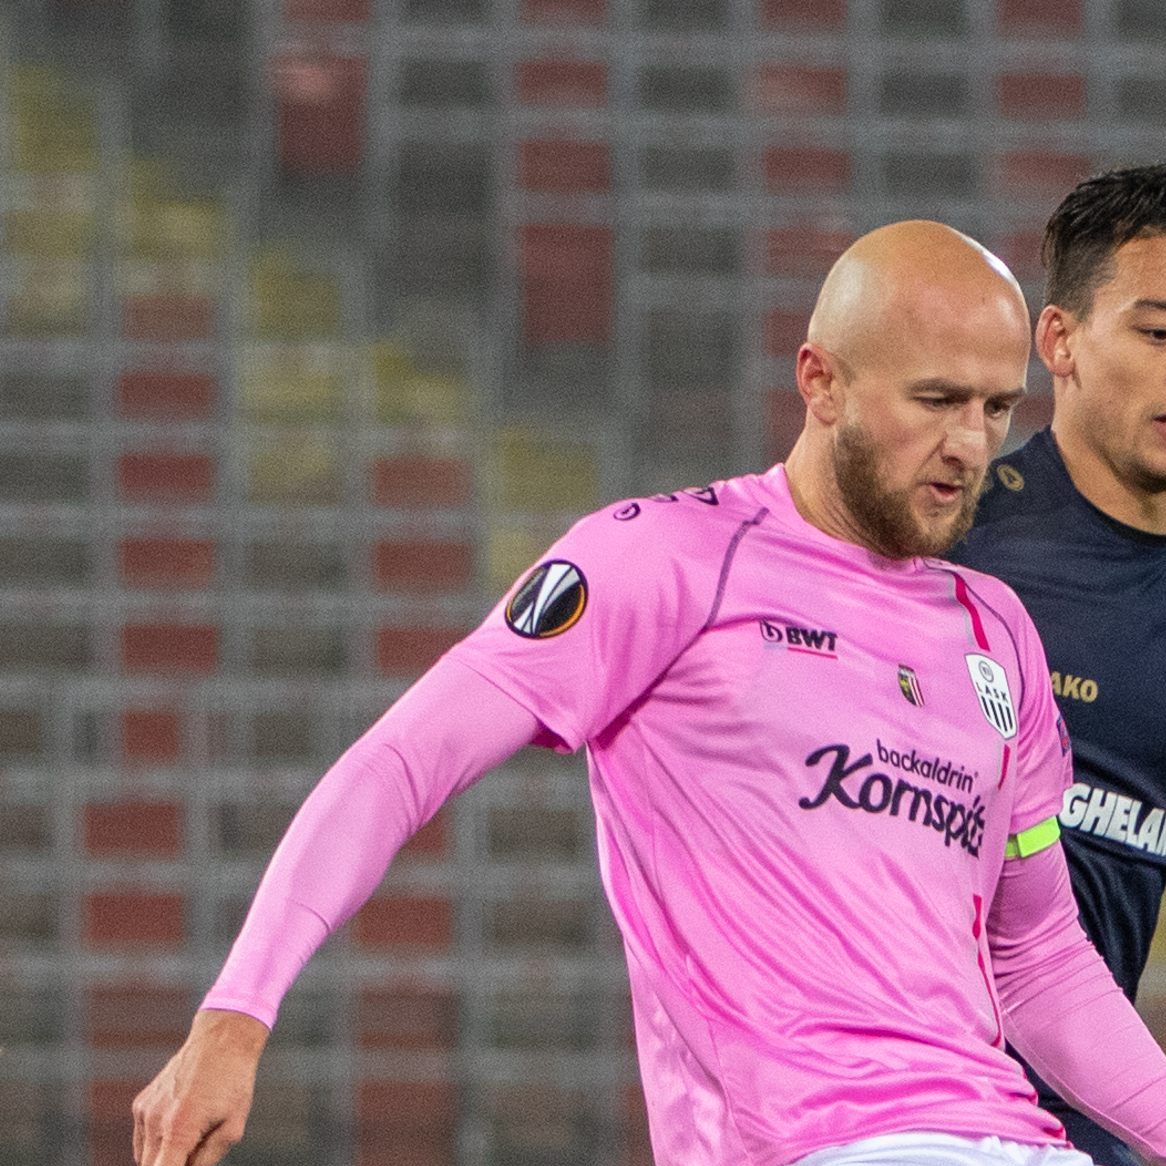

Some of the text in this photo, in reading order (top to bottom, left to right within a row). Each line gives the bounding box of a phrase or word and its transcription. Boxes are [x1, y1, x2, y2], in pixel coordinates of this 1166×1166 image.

[786, 626, 839, 651] BWT
[1050, 671, 1099, 703] AKO
[876, 738, 974, 794] backaldrin
